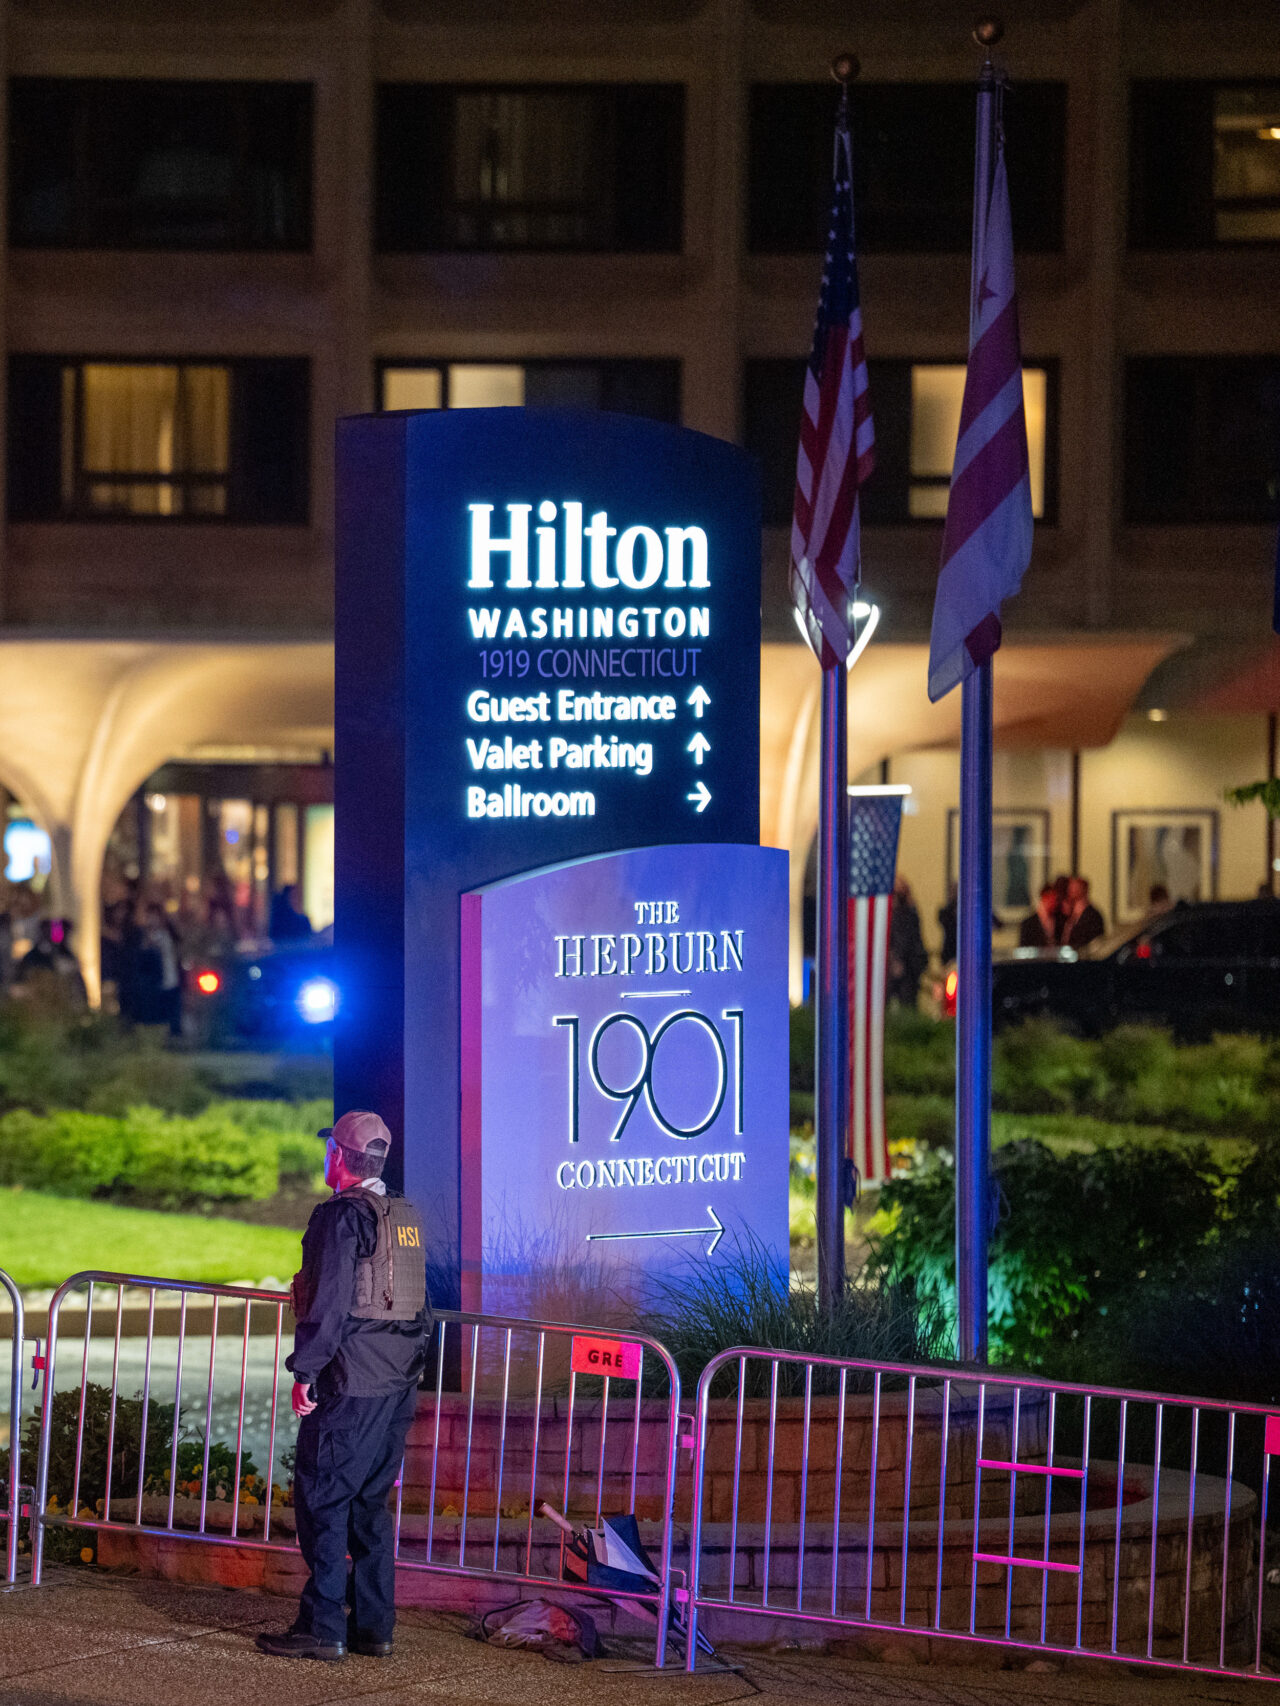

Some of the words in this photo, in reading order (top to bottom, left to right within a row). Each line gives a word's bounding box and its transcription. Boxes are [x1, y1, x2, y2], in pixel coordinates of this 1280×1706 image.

[467, 500, 711, 589] Hilton
[468, 607, 710, 638] WASHINGTON
[479, 650, 530, 678] 1919
[537, 648, 702, 678] CONNECTICUT
[467, 690, 551, 722] Guest
[558, 690, 677, 721] Entrance
[466, 737, 543, 770] Valet
[550, 735, 653, 775] Parking
[467, 784, 596, 818] Ballroom
[634, 901, 680, 925] THE
[554, 930, 744, 978] HEPBURN
[552, 1009, 744, 1143] 1901
[556, 1152, 746, 1190] CONNECTICUT
[397, 1225, 420, 1247] HSI
[587, 1349, 624, 1368] GRE
